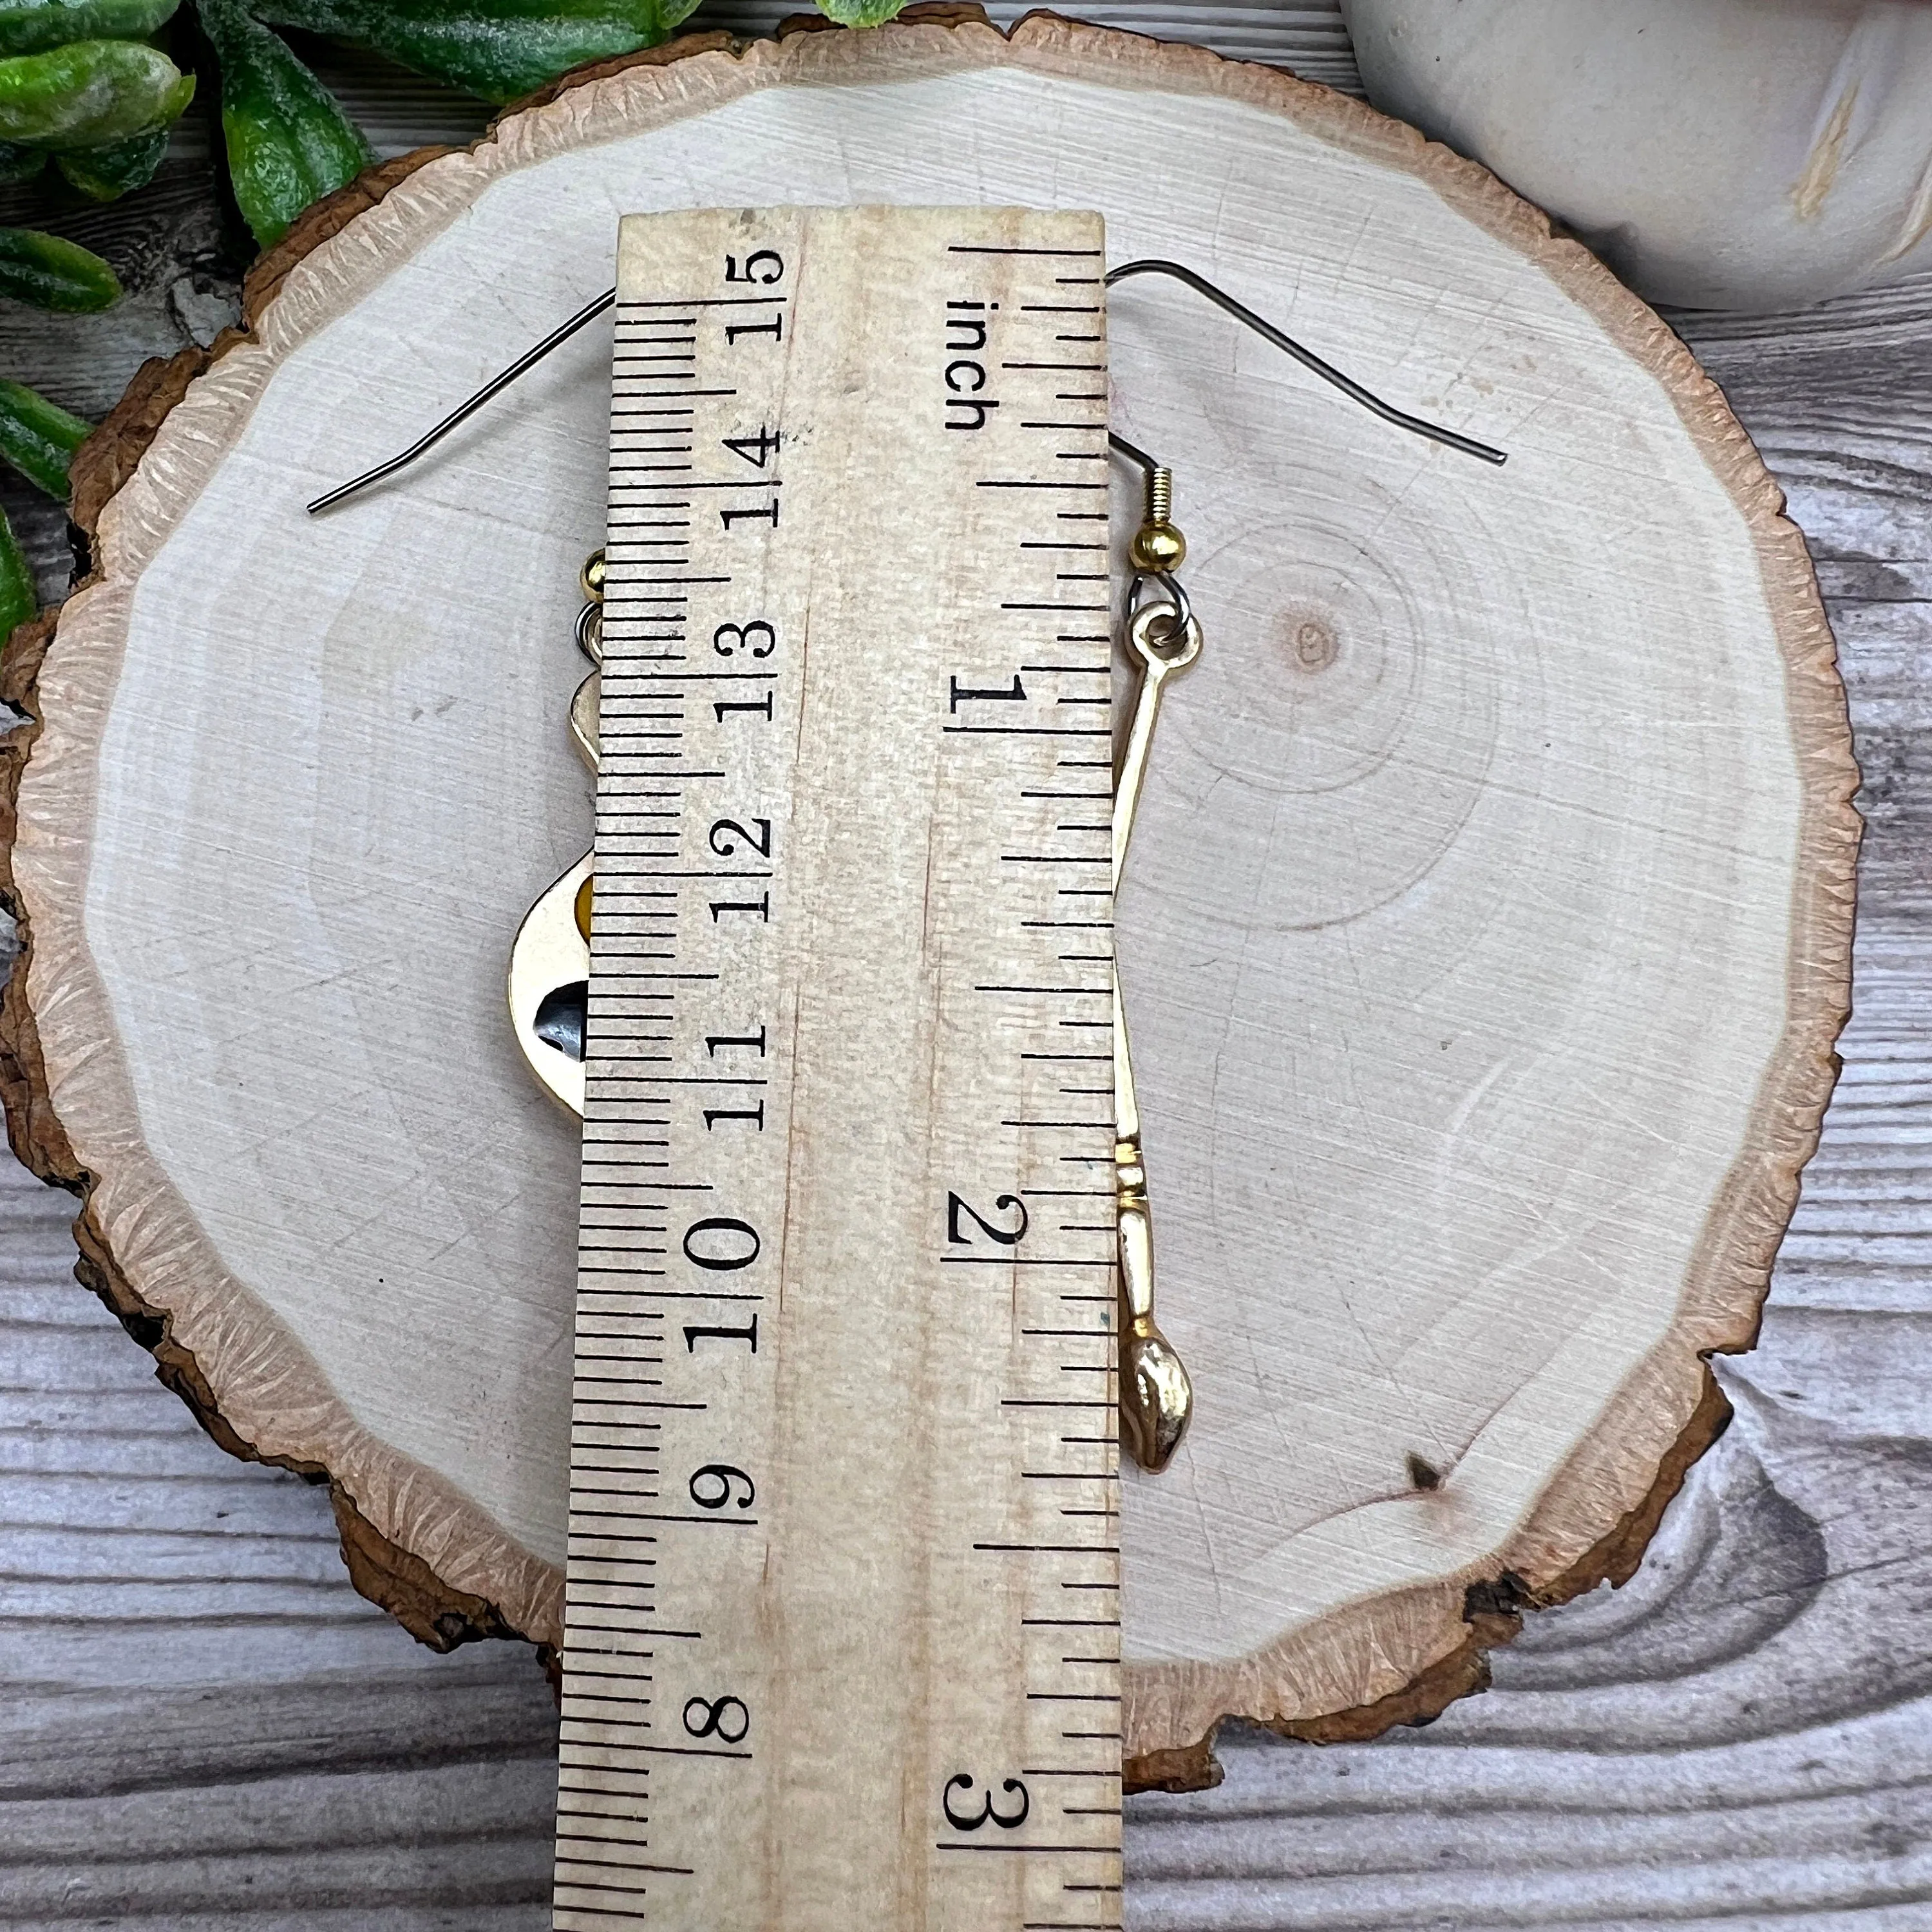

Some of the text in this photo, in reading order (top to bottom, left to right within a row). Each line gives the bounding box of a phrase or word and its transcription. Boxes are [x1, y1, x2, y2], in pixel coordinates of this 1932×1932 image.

[725, 249, 784, 345] 15
[944, 301, 999, 430] inch
[720, 426, 781, 530] 14
[713, 620, 775, 723] 13
[950, 675, 1027, 714] 1
[709, 817, 772, 923] 12
[703, 1025, 766, 1132] 11
[948, 1190, 1028, 1245] 2
[683, 1217, 761, 1354] 10
[689, 1464, 755, 1509] 9
[683, 1696, 750, 1743] 8
[943, 1773, 1029, 1831] 3
